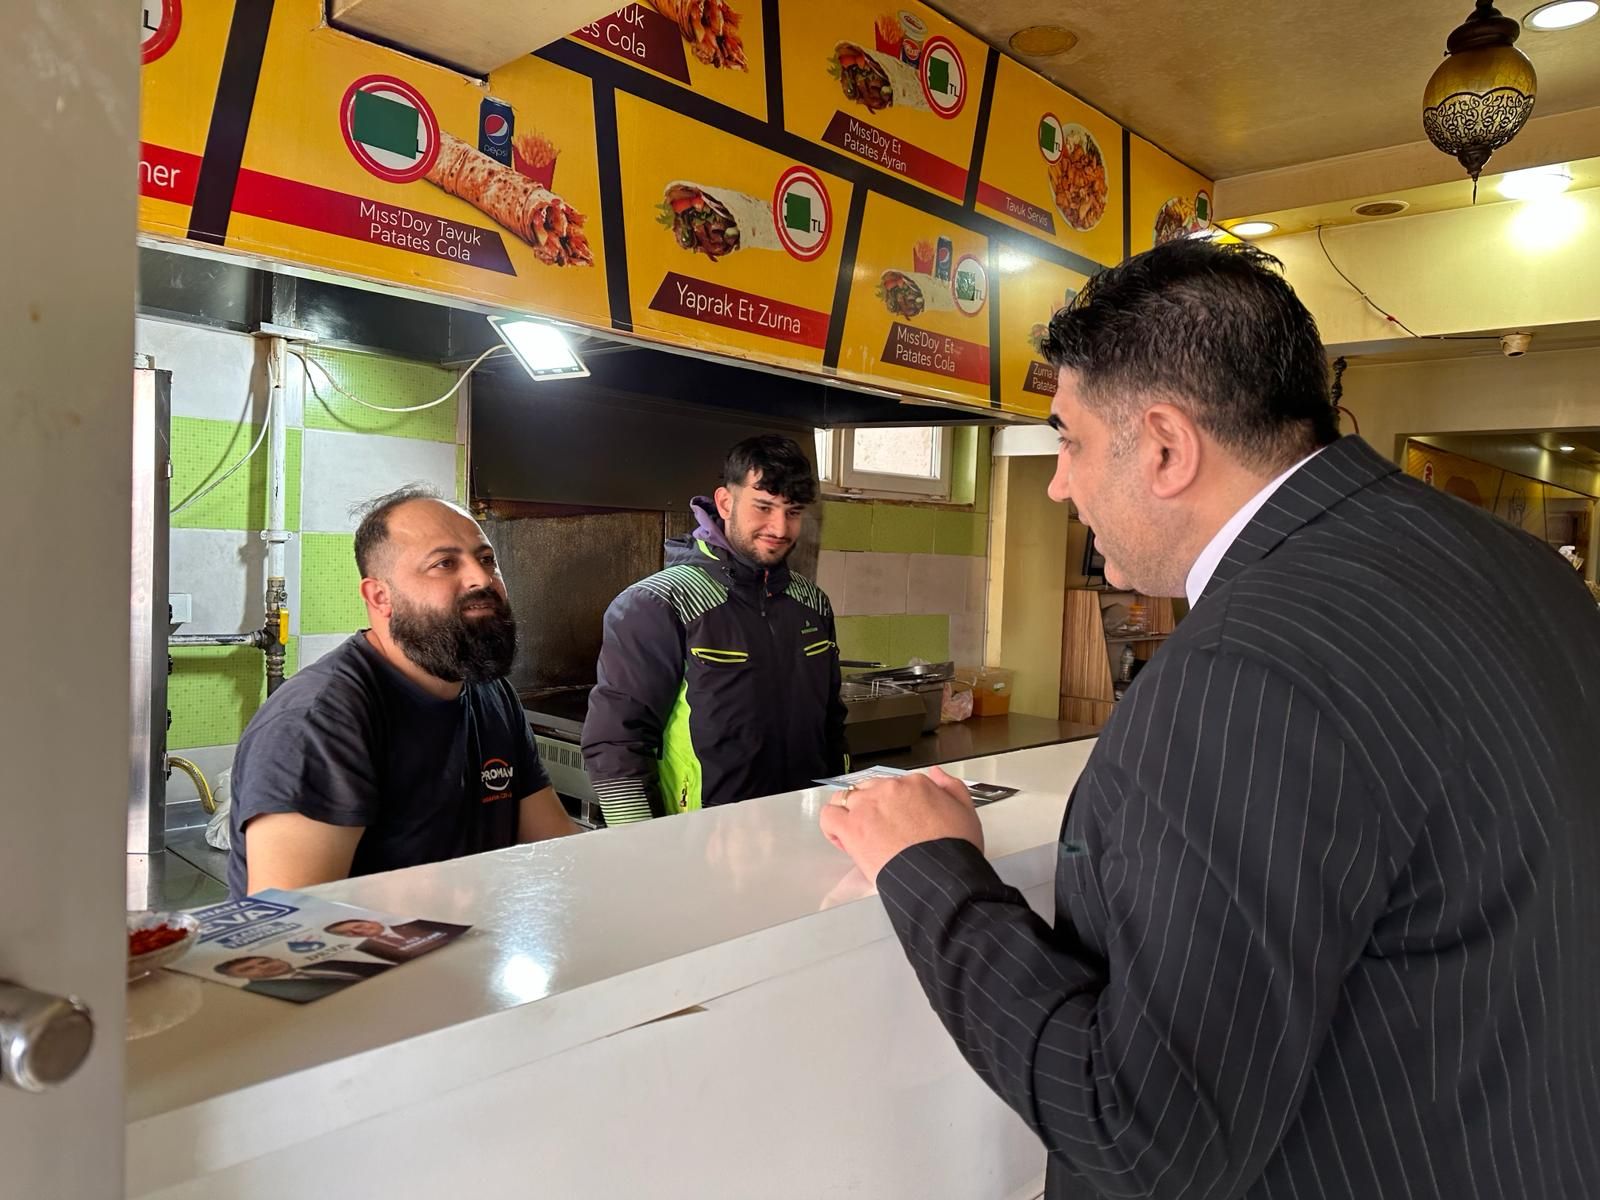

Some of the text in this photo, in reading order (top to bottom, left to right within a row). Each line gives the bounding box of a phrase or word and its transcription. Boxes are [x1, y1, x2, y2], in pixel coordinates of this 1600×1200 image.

[606, 23, 646, 58] Cola
[843, 132, 907, 173] Patates Ayran
[891, 138, 901, 155] Et
[1006, 196, 1026, 217] Tavuk
[437, 219, 481, 246] Tavuk
[811, 218, 825, 234] TL
[370, 222, 470, 261] Patates Cola
[676, 281, 801, 334] Yaprak Et Zurna
[895, 343, 956, 373] Patates Cola
[944, 337, 954, 354] Et
